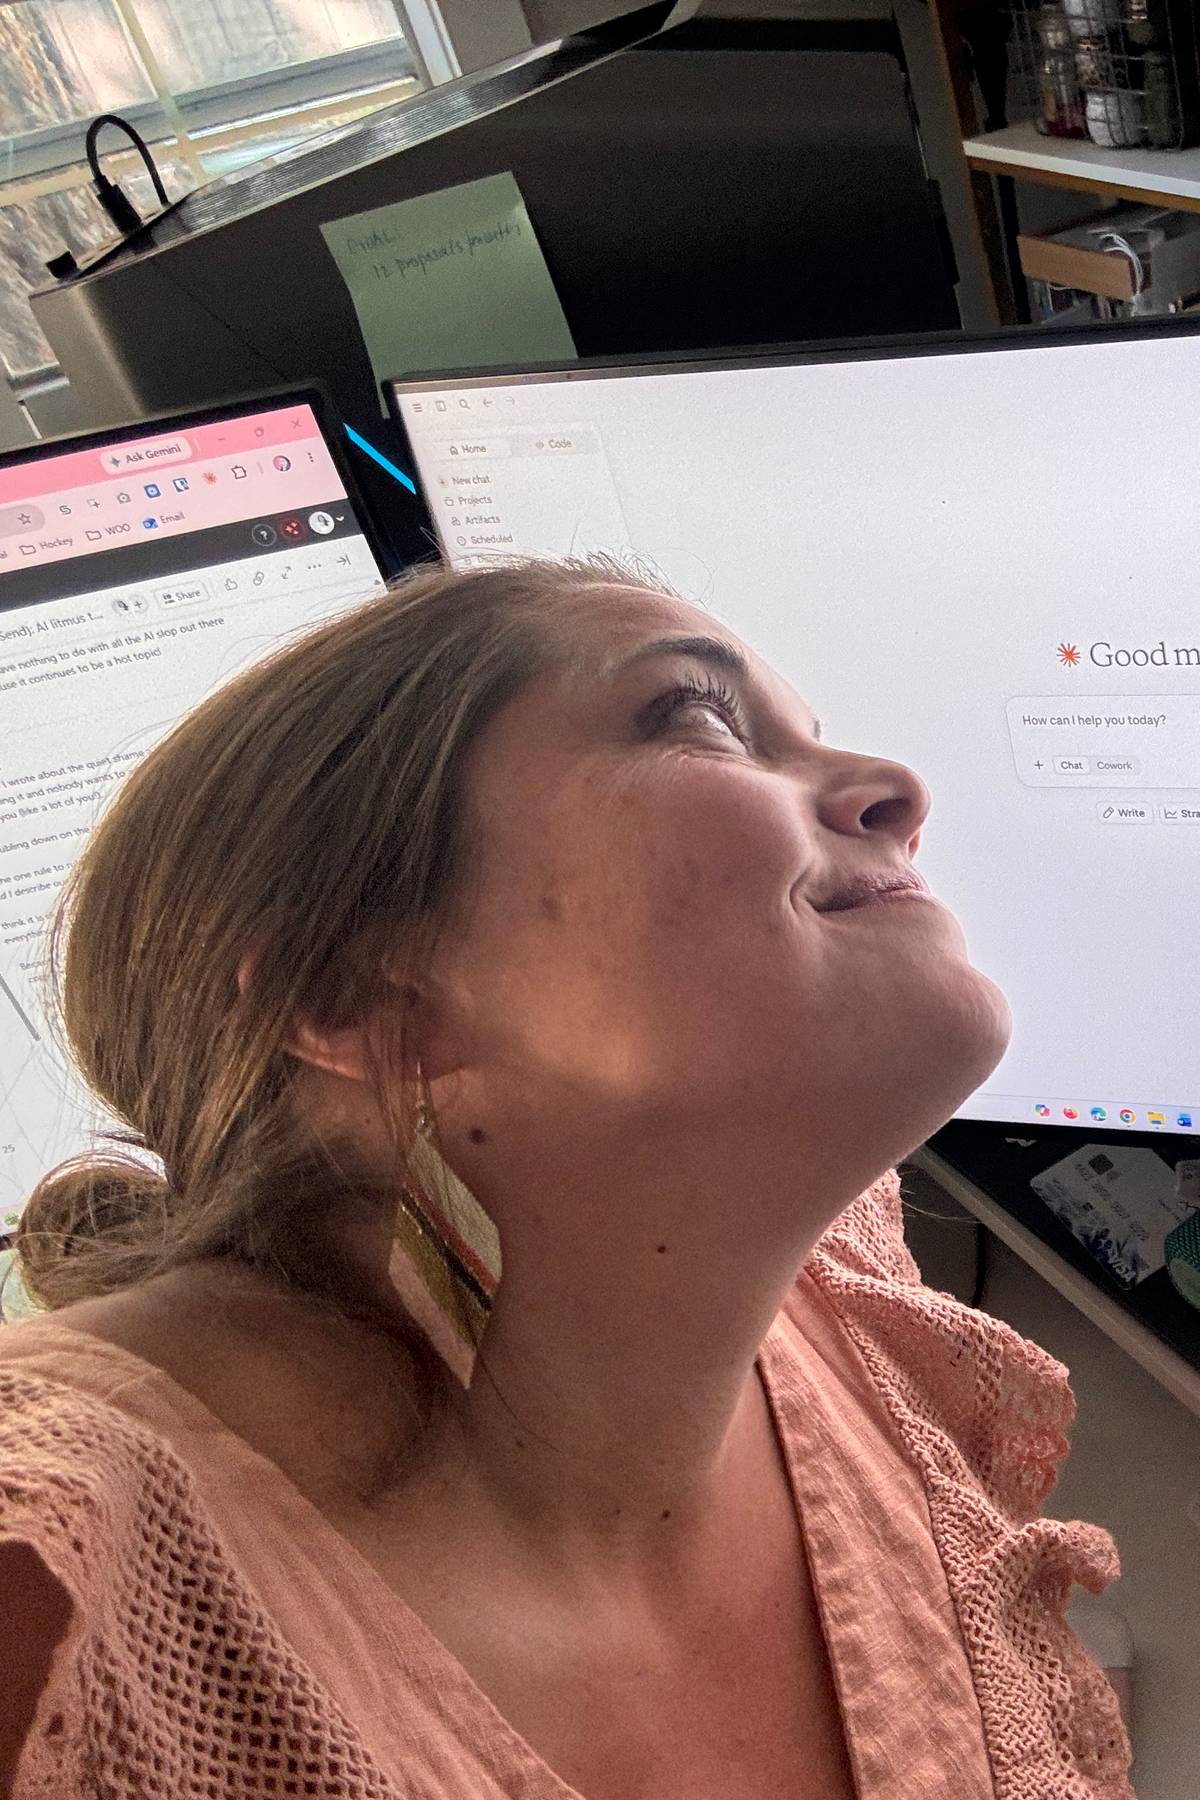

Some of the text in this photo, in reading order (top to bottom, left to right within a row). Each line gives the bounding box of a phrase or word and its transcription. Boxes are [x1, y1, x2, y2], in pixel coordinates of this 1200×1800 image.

[462, 439, 572, 453] Home Code
[126, 443, 181, 463] Ask Gemini
[452, 474, 491, 485] New chat
[458, 496, 492, 506] Projects
[160, 512, 185, 524] Email
[465, 515, 501, 525] Artifacts
[471, 534, 513, 544] Scheduled
[175, 590, 201, 601] Share
[50, 615, 87, 630] litmus
[19, 655, 58, 669] nothing
[59, 651, 70, 661] to
[73, 648, 87, 658] do
[89, 642, 109, 654] with
[125, 635, 142, 646] the
[157, 628, 178, 640] slop
[180, 623, 197, 634] out
[199, 617, 224, 629] there
[1089, 641, 1168, 669] Good
[29, 667, 77, 684] continues
[78, 664, 90, 673] to
[92, 660, 104, 670] be
[115, 654, 133, 665] hot
[1022, 715, 1048, 726] How
[1049, 716, 1070, 727] can
[1077, 714, 1102, 728] help
[1104, 717, 1125, 728] you
[1128, 714, 1166, 728] today?
[38, 768, 67, 779] about
[68, 764, 84, 773] the
[1060, 760, 1083, 771] Chat
[1096, 760, 1133, 771] Cowork
[1117, 808, 1146, 819] Write
